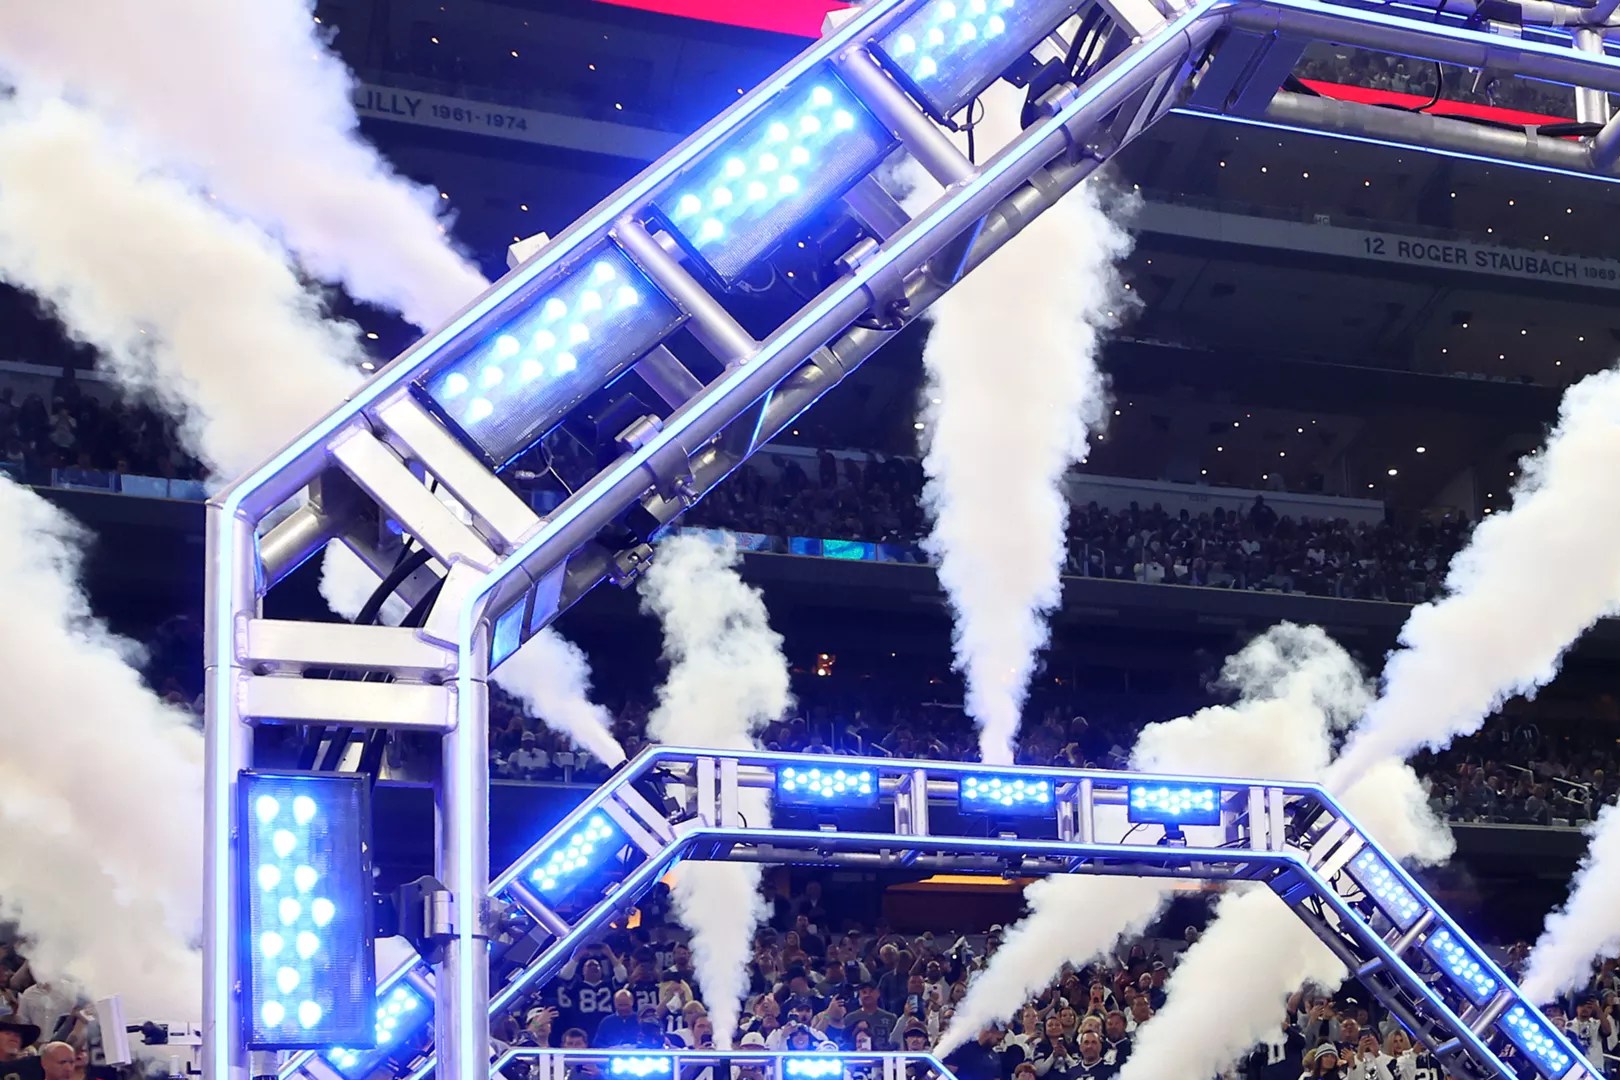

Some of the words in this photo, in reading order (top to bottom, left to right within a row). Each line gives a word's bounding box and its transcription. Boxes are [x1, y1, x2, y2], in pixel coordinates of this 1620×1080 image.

[1363, 237, 1386, 255] 12
[1397, 240, 1468, 265] ROGER
[1474, 250, 1578, 279] STAUBACH
[579, 986, 613, 1013] 82
